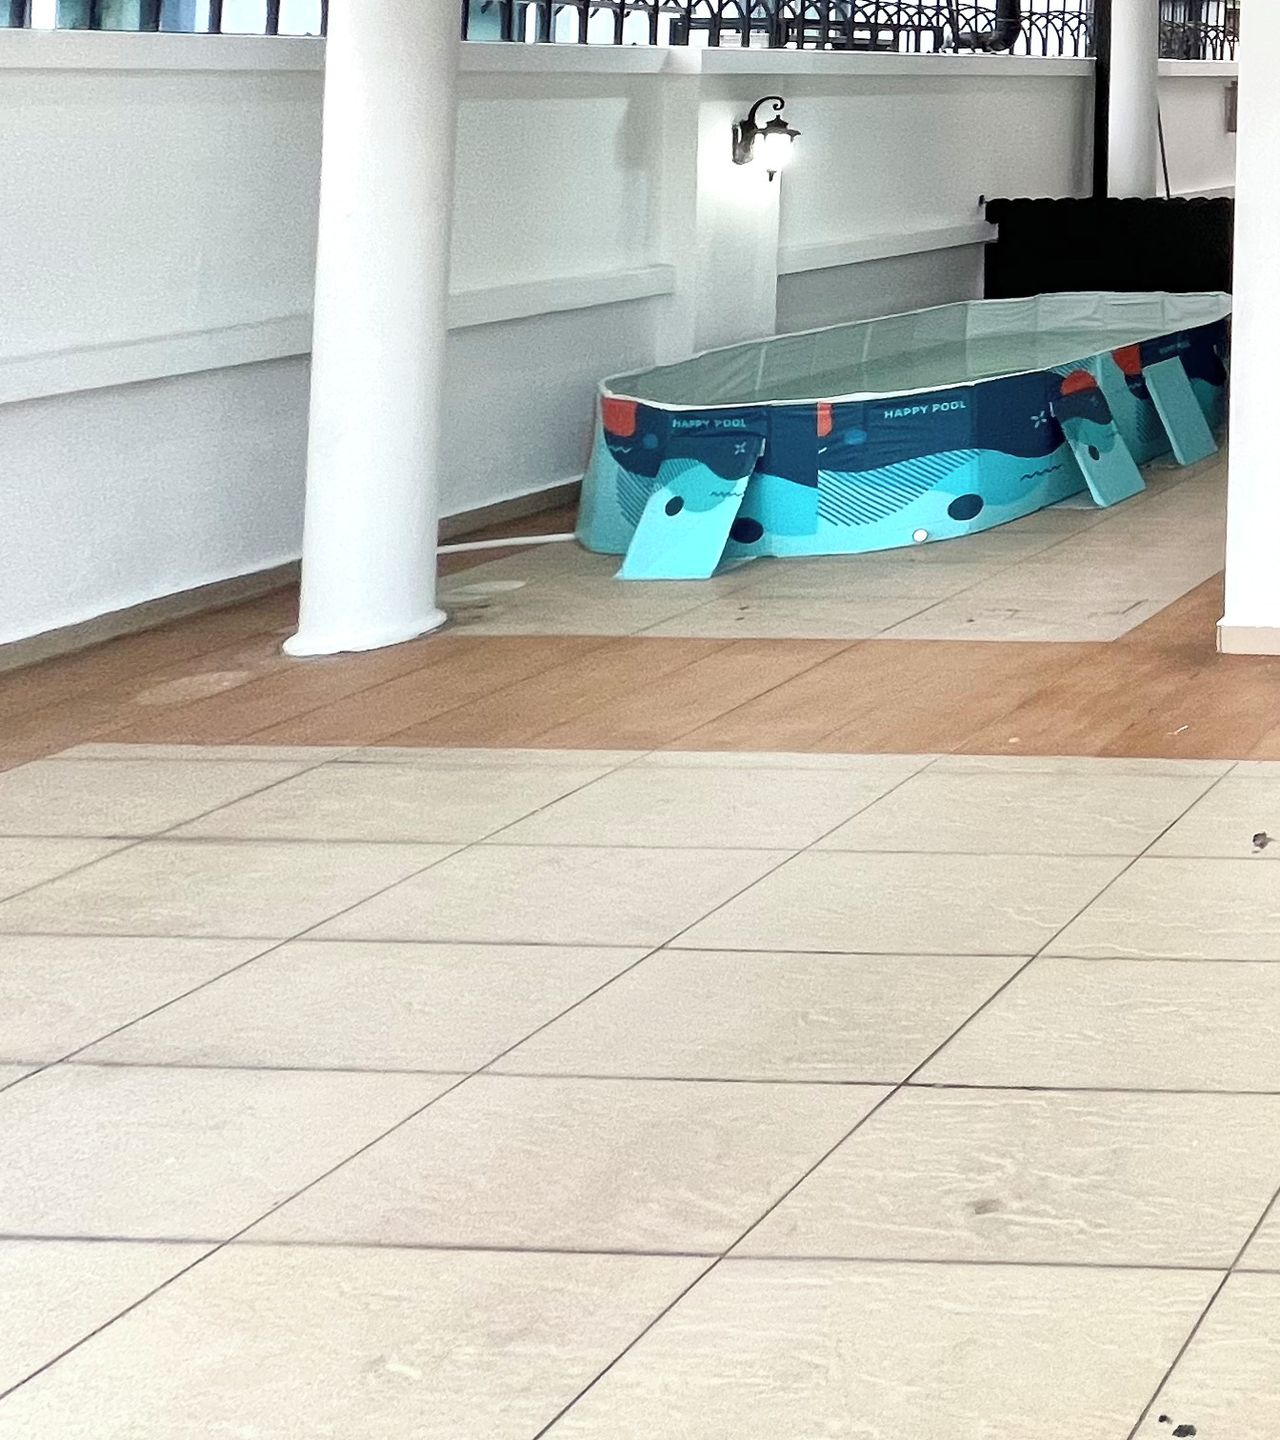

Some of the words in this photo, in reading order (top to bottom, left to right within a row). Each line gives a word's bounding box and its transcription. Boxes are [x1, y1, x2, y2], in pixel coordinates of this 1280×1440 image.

[883, 405, 928, 419] HAPPY
[932, 400, 967, 413] POOL
[672, 418, 710, 428] HAPPY
[715, 418, 747, 428] POOL
